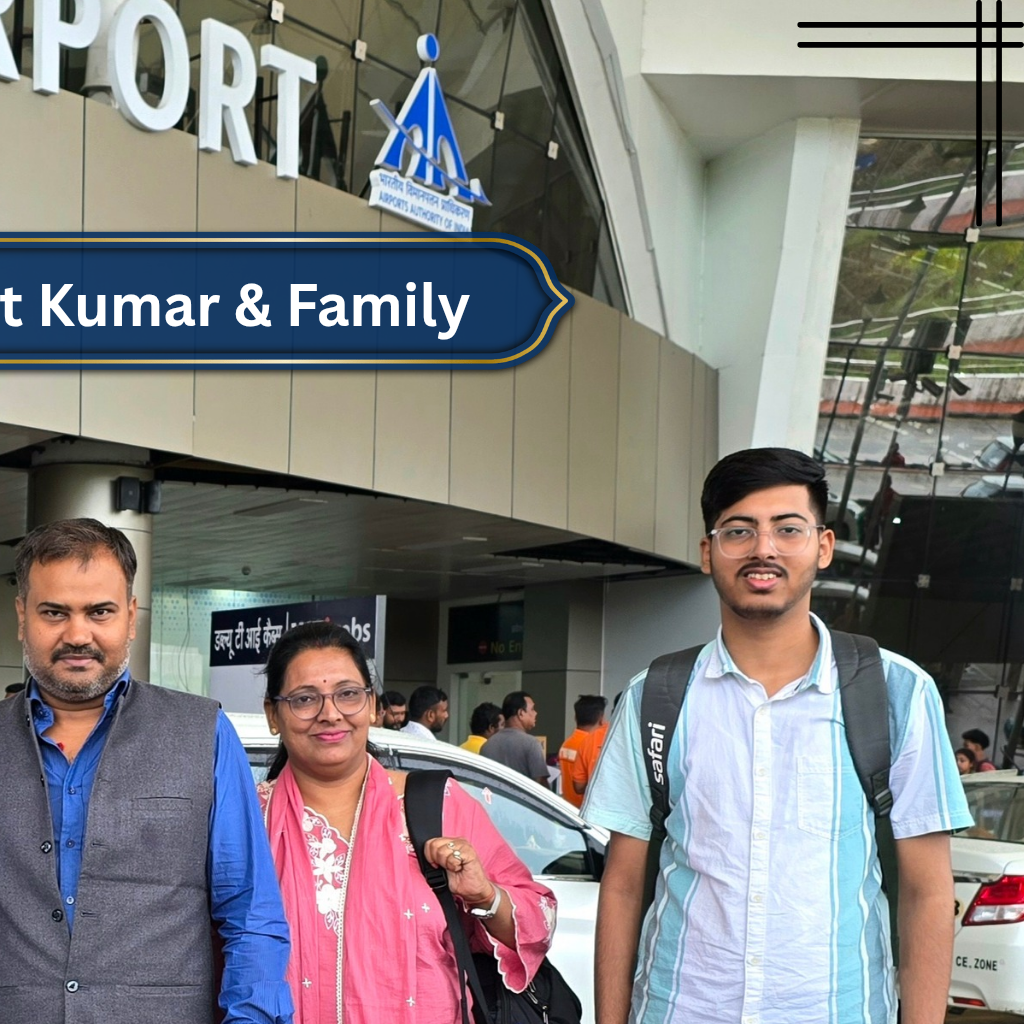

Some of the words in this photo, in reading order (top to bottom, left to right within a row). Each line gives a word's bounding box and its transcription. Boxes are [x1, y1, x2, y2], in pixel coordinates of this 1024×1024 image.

[379, 191, 409, 212] AIRPORTS
[410, 203, 444, 226] AUTHORITY
[443, 217, 454, 230] OF
[234, 620, 244, 650] टी
[244, 617, 261, 654] आई
[490, 641, 505, 655] No
[508, 640, 522, 653] En
[647, 721, 666, 786] safari
